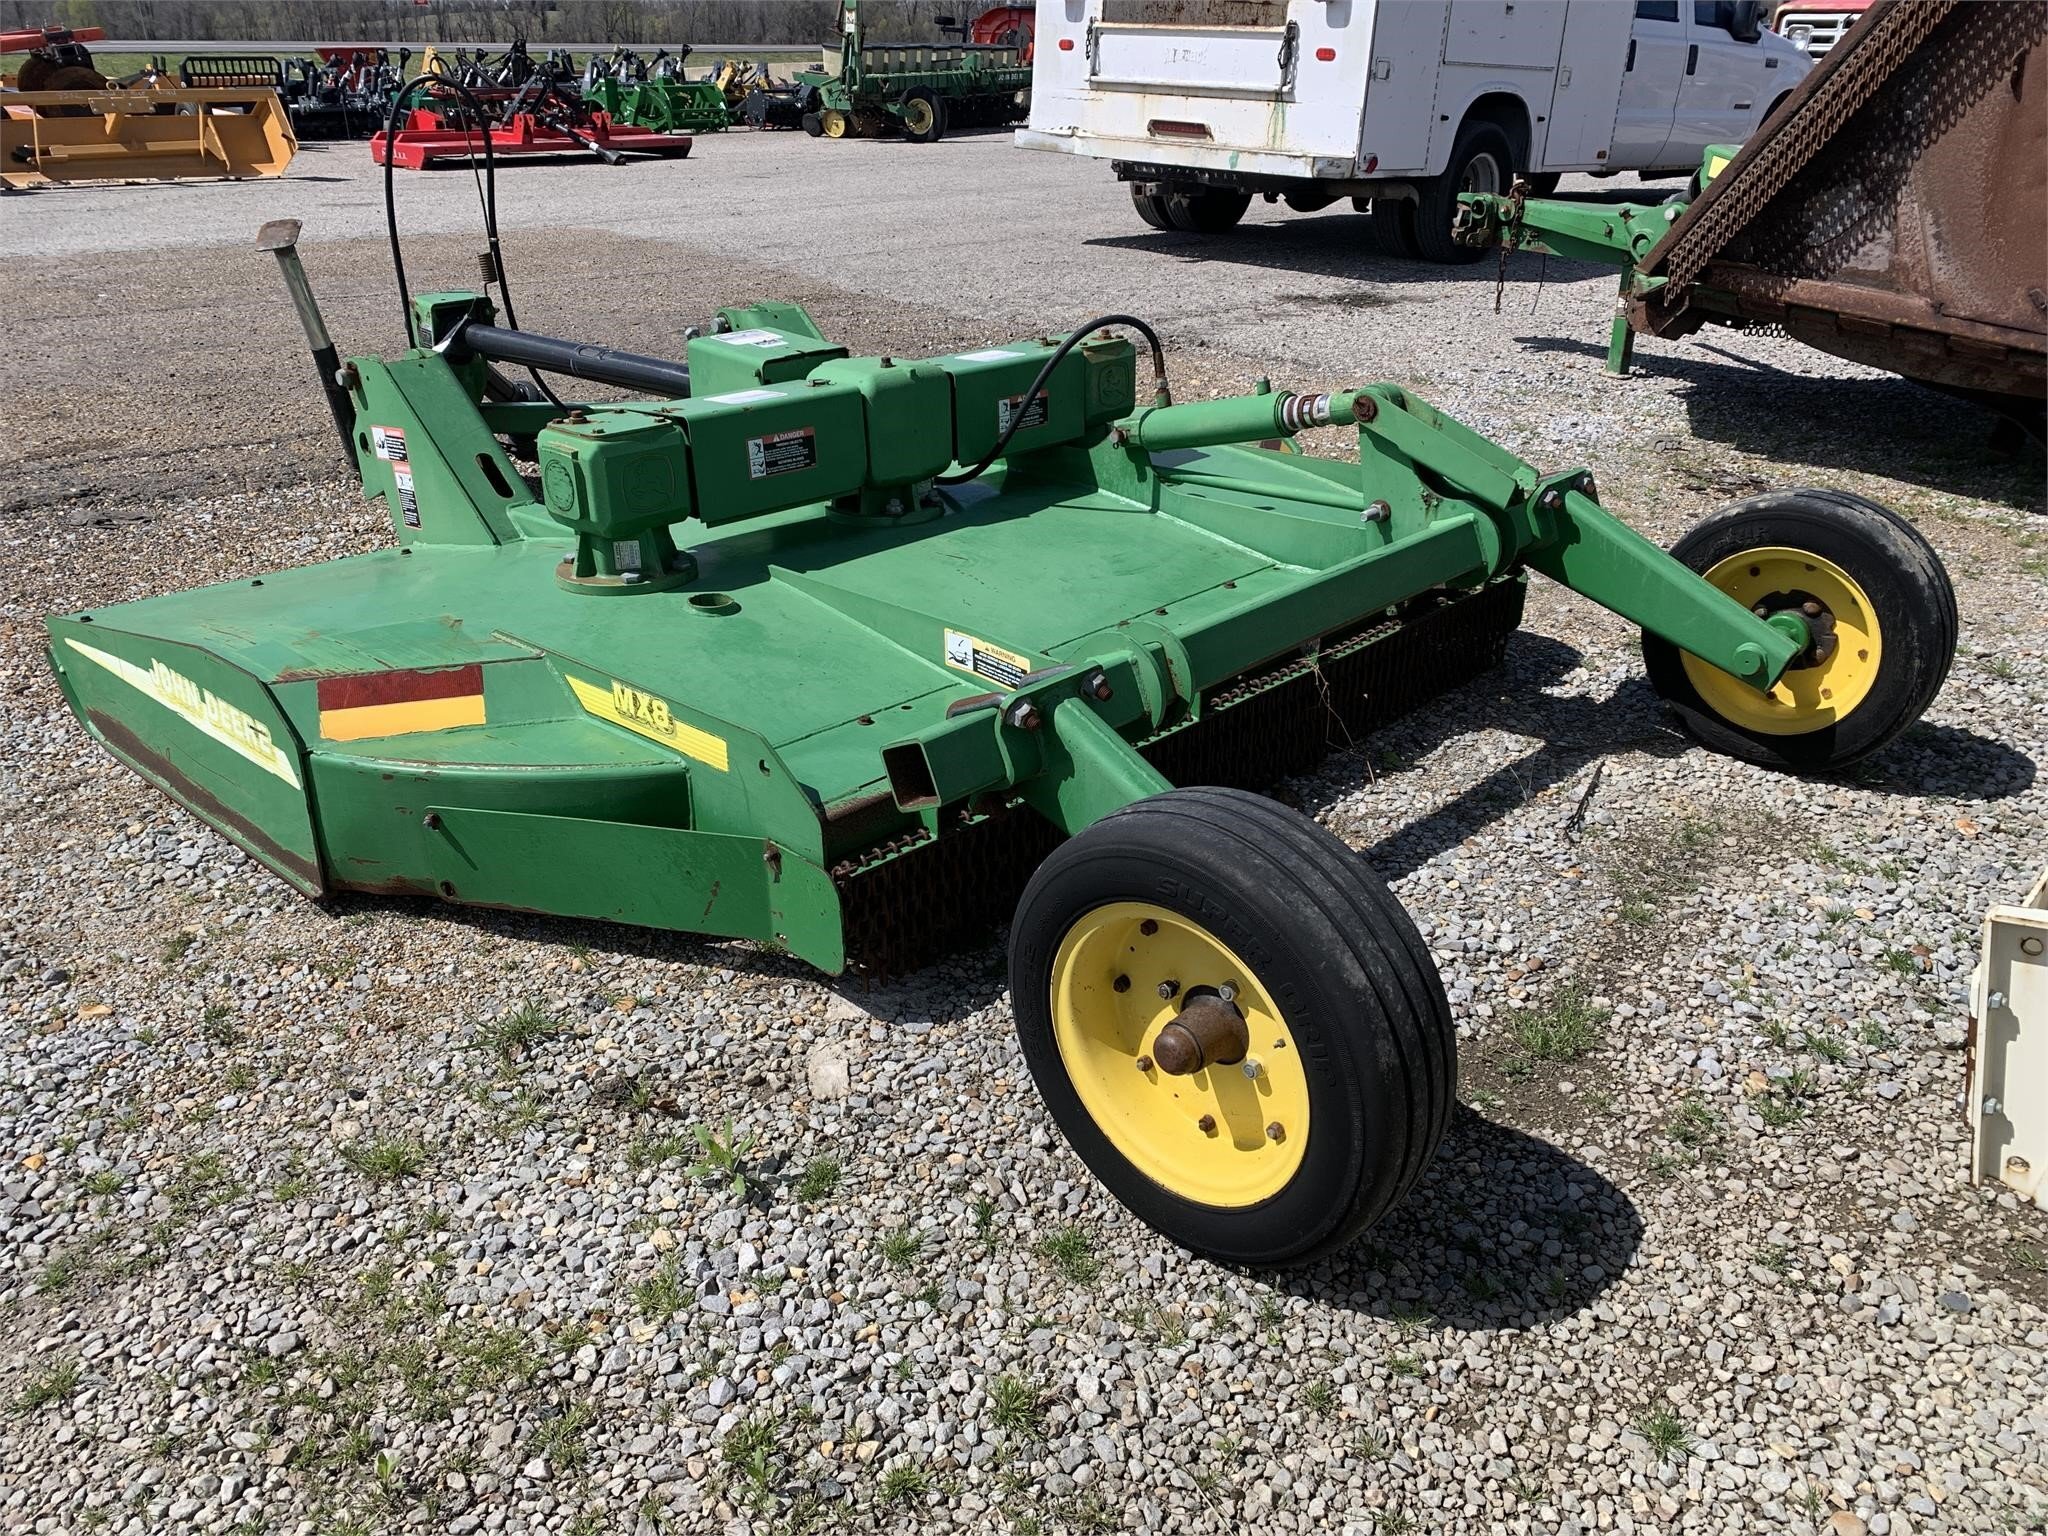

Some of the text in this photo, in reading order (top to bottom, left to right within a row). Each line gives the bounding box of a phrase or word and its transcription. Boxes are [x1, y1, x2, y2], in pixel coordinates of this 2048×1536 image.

[780, 430, 804, 440] DANGER
[990, 646, 1016, 662] WARNING
[148, 657, 274, 761] JOHN DEERE
[611, 680, 675, 734] MX8
[1155, 875, 1337, 1089] SUPER GRIP
